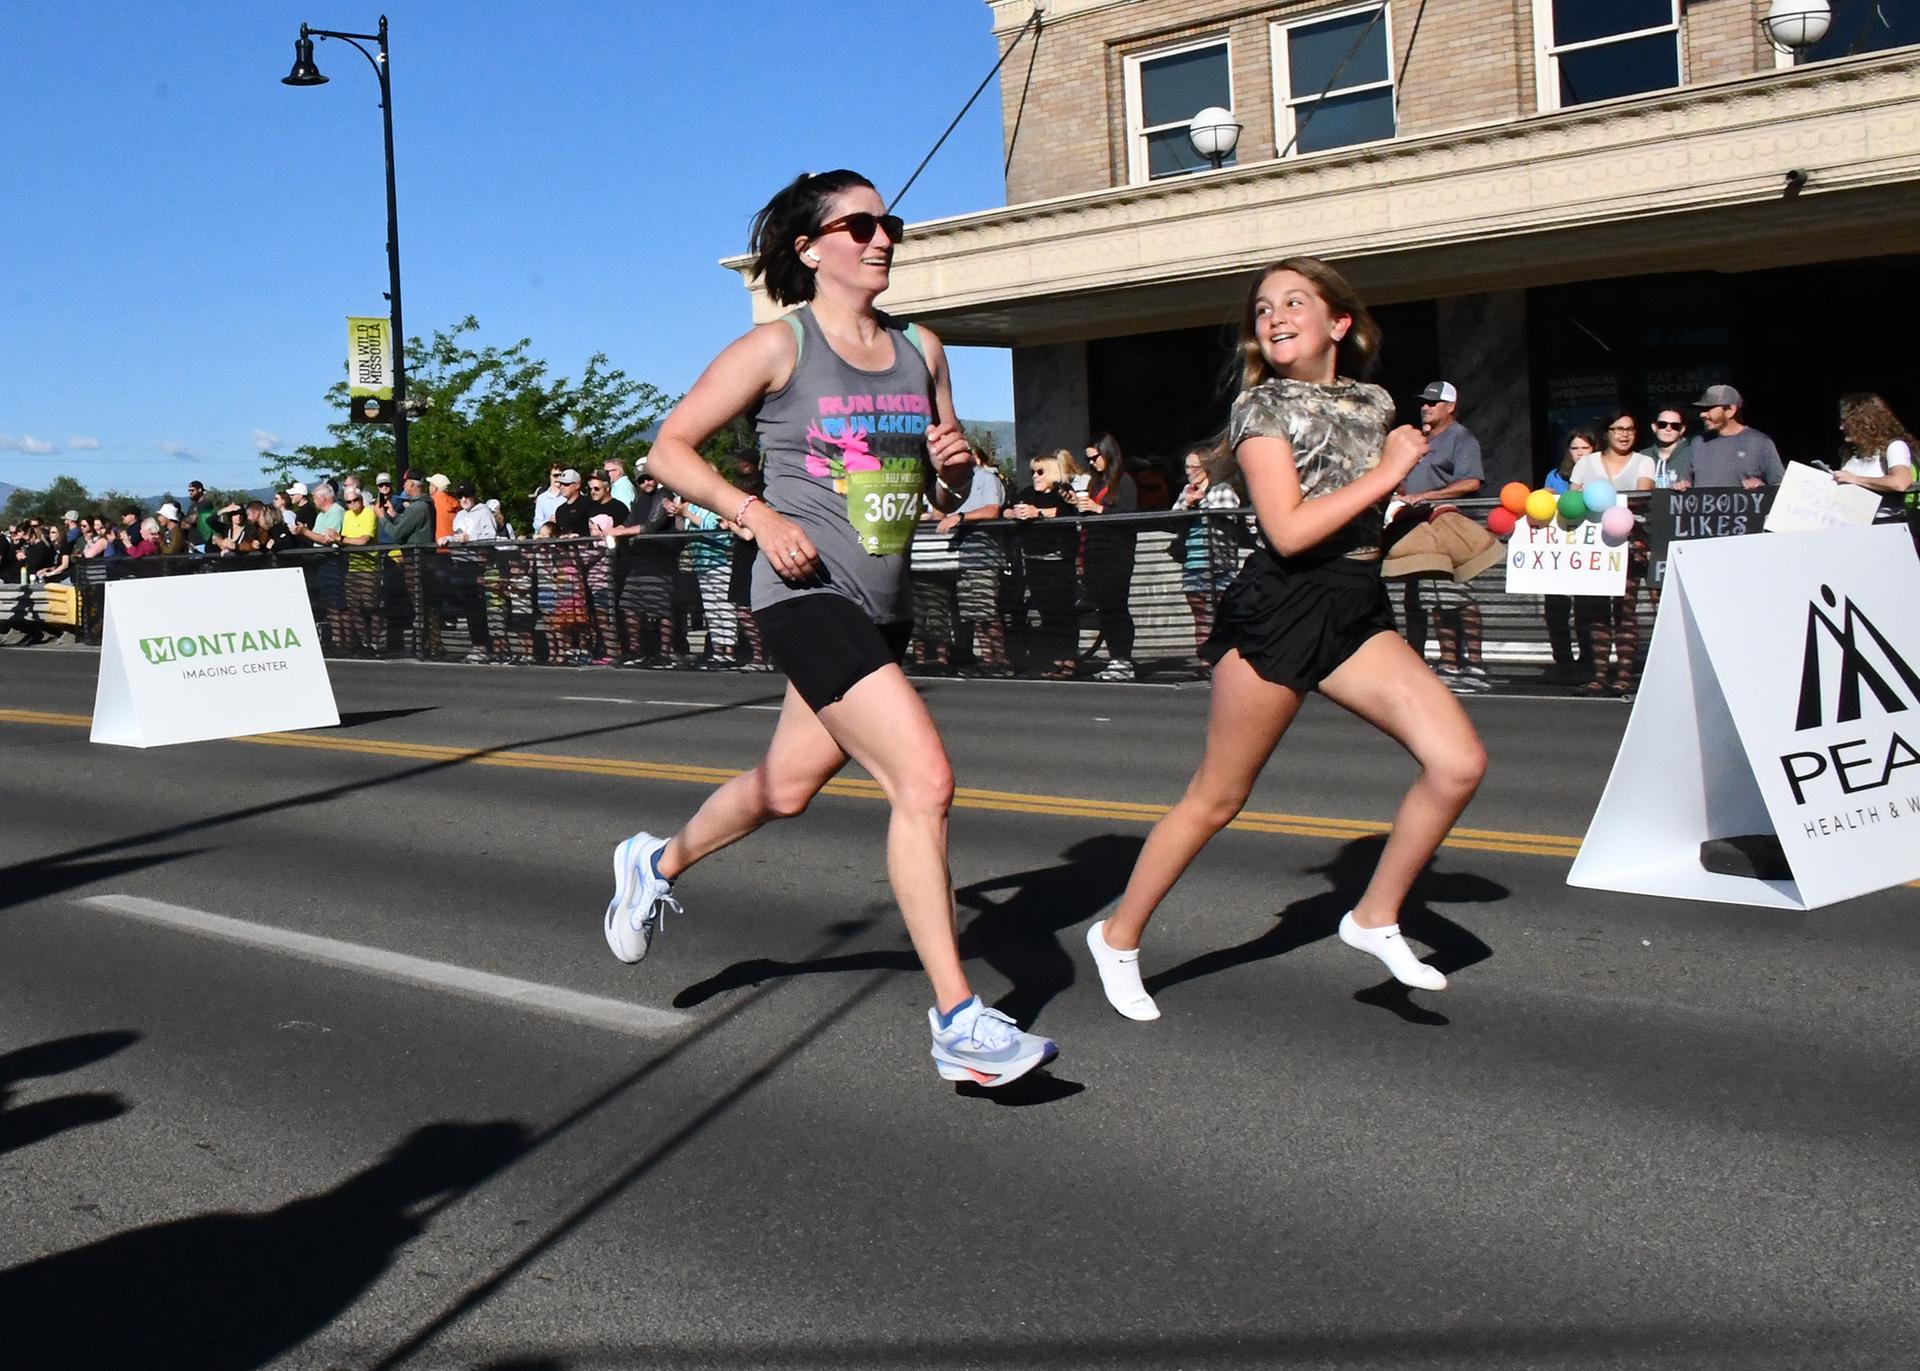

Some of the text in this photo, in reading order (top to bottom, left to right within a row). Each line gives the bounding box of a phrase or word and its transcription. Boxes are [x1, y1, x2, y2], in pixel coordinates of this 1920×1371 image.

[358, 324, 370, 384] RUN WILD
[370, 324, 382, 384] MISSOULA
[1647, 382, 1708, 394] ROCKST
[818, 395, 874, 415] RUN
[864, 492, 918, 523] 3674
[1669, 493, 1764, 514] NOBODY
[1530, 525, 1597, 545] FREE
[1675, 515, 1748, 537] LIKES
[1512, 549, 1621, 572] OXYGEN
[140, 627, 302, 664] MONTANA
[182, 660, 288, 680] IMAGING CENTER
[1803, 807, 1880, 839] HEALTH
[1889, 801, 1901, 819] &
